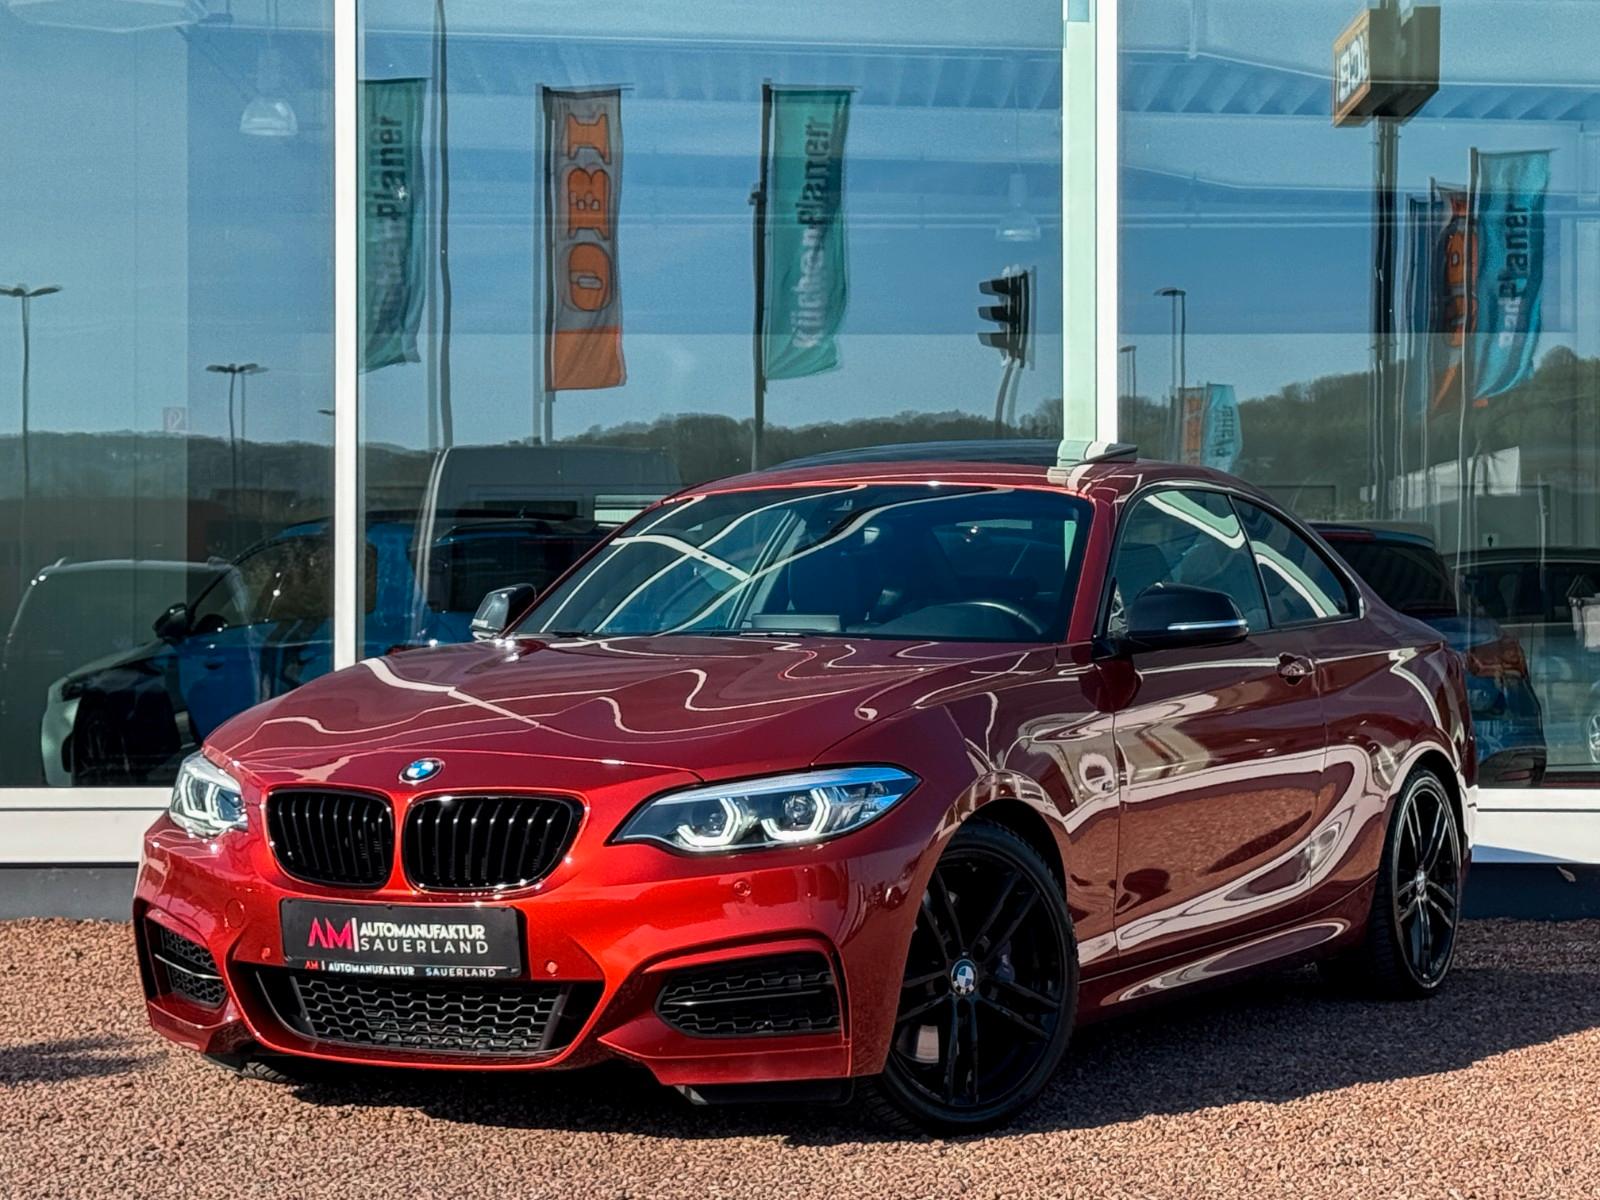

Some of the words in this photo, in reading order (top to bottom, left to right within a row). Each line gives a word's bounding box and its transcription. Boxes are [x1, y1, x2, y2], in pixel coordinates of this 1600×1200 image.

[567, 113, 611, 311] OBI
[359, 922, 486, 940] AUTOMANUFAKTUR
[360, 939, 489, 954] SAUERLAND
[328, 962, 415, 976] AUTOMANUFAKTUR
[425, 967, 496, 978] SAUERLAND
